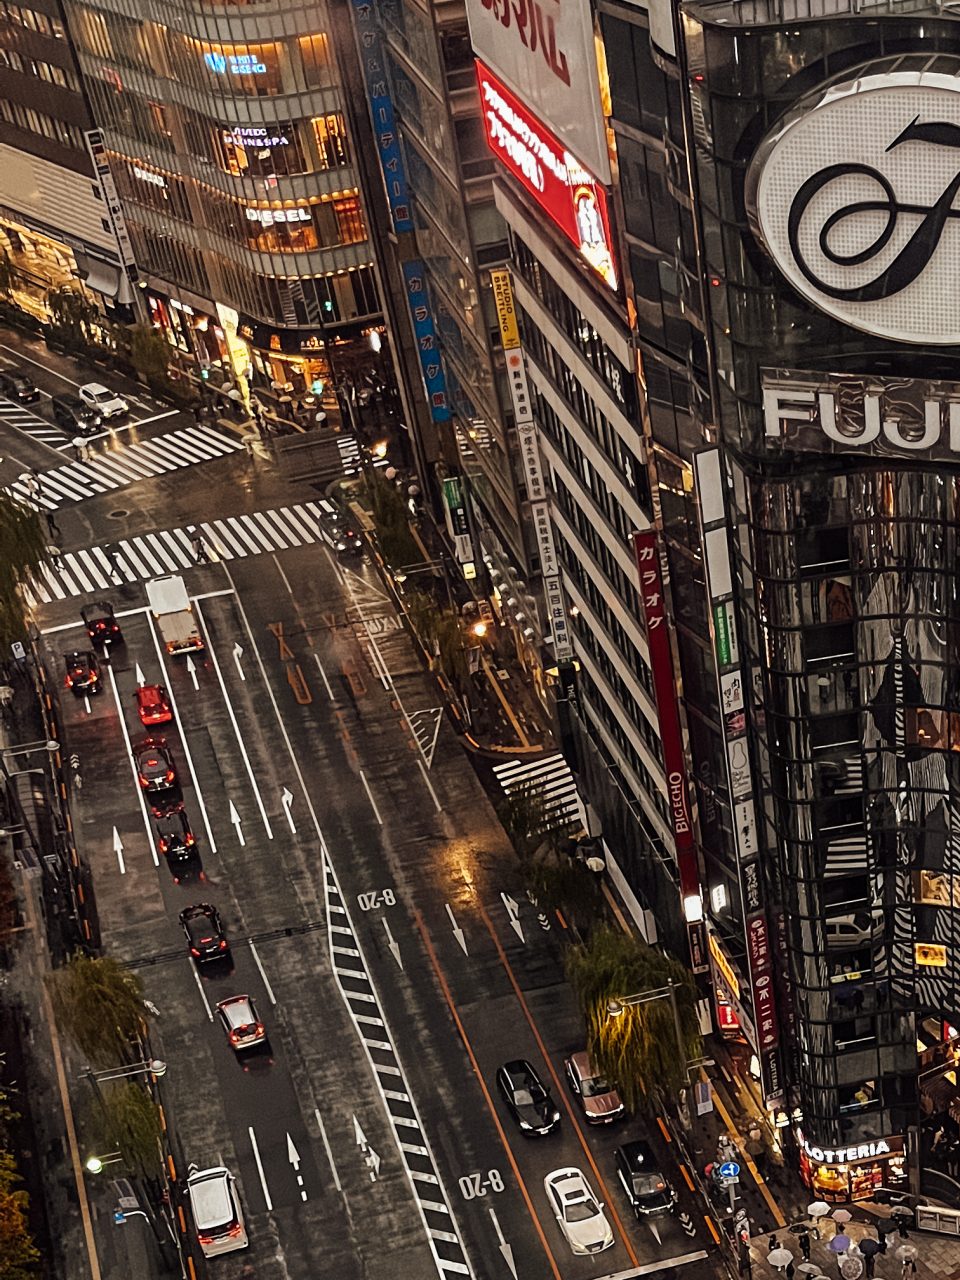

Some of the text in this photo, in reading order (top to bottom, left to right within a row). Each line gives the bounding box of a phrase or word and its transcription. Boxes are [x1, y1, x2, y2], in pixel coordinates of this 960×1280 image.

[246, 208, 312, 223] DIESEL
[494, 276, 509, 332] BREITLING
[501, 275, 513, 314] STUDIO
[640, 546, 663, 630] カラオケ
[357, 887, 397, 912] 8-20
[758, 987, 773, 1032] 不二家
[804, 1138, 890, 1164] LOTTERIA
[459, 1168, 505, 1200] 8-20
